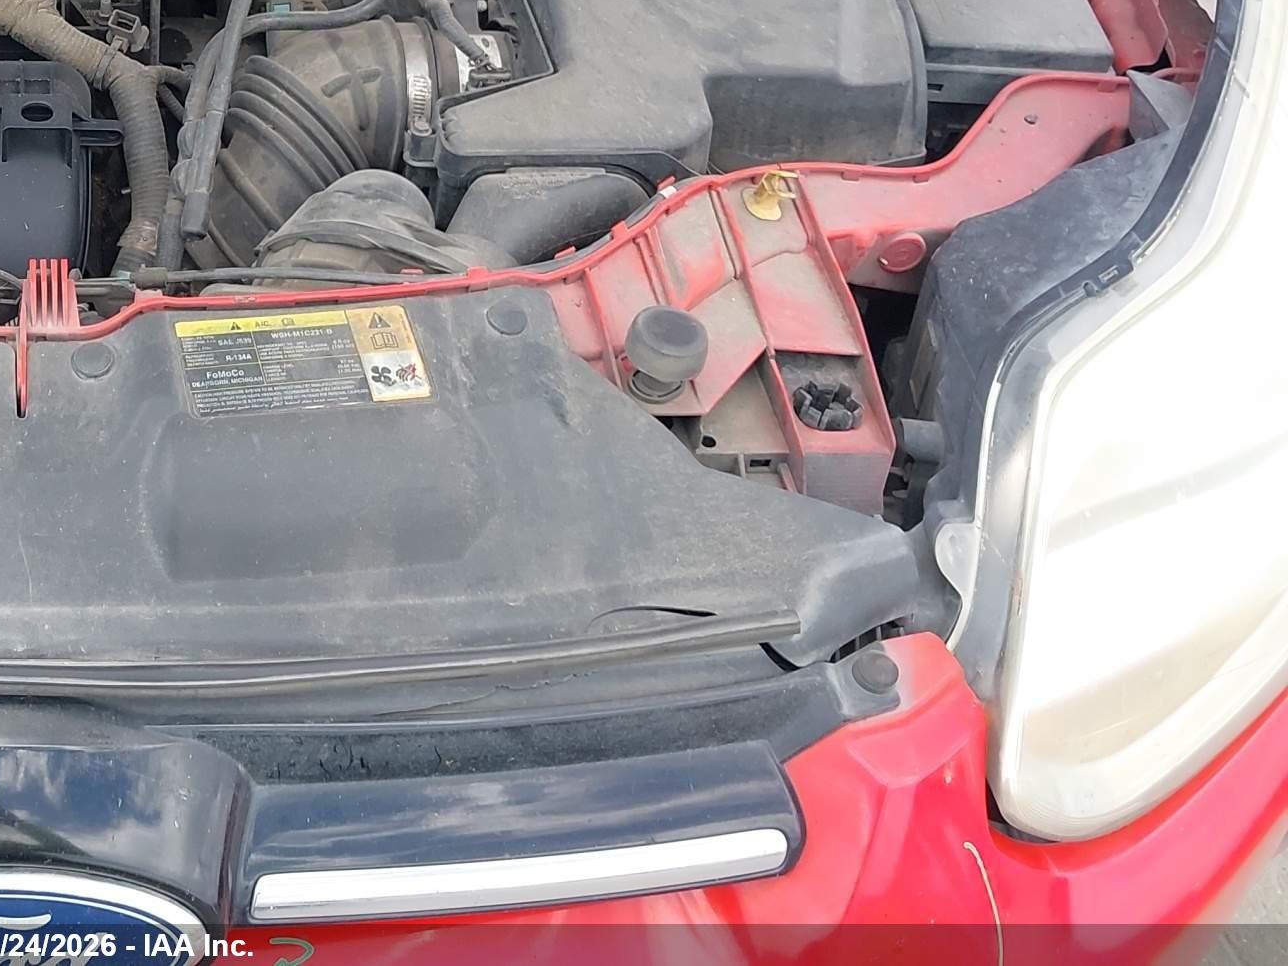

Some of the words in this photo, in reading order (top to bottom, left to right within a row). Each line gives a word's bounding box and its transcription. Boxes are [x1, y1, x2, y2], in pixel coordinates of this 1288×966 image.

[225, 353, 252, 362] R-134A
[206, 369, 245, 379] FoMoCo
[230, 376, 263, 384] MICHIGAN
